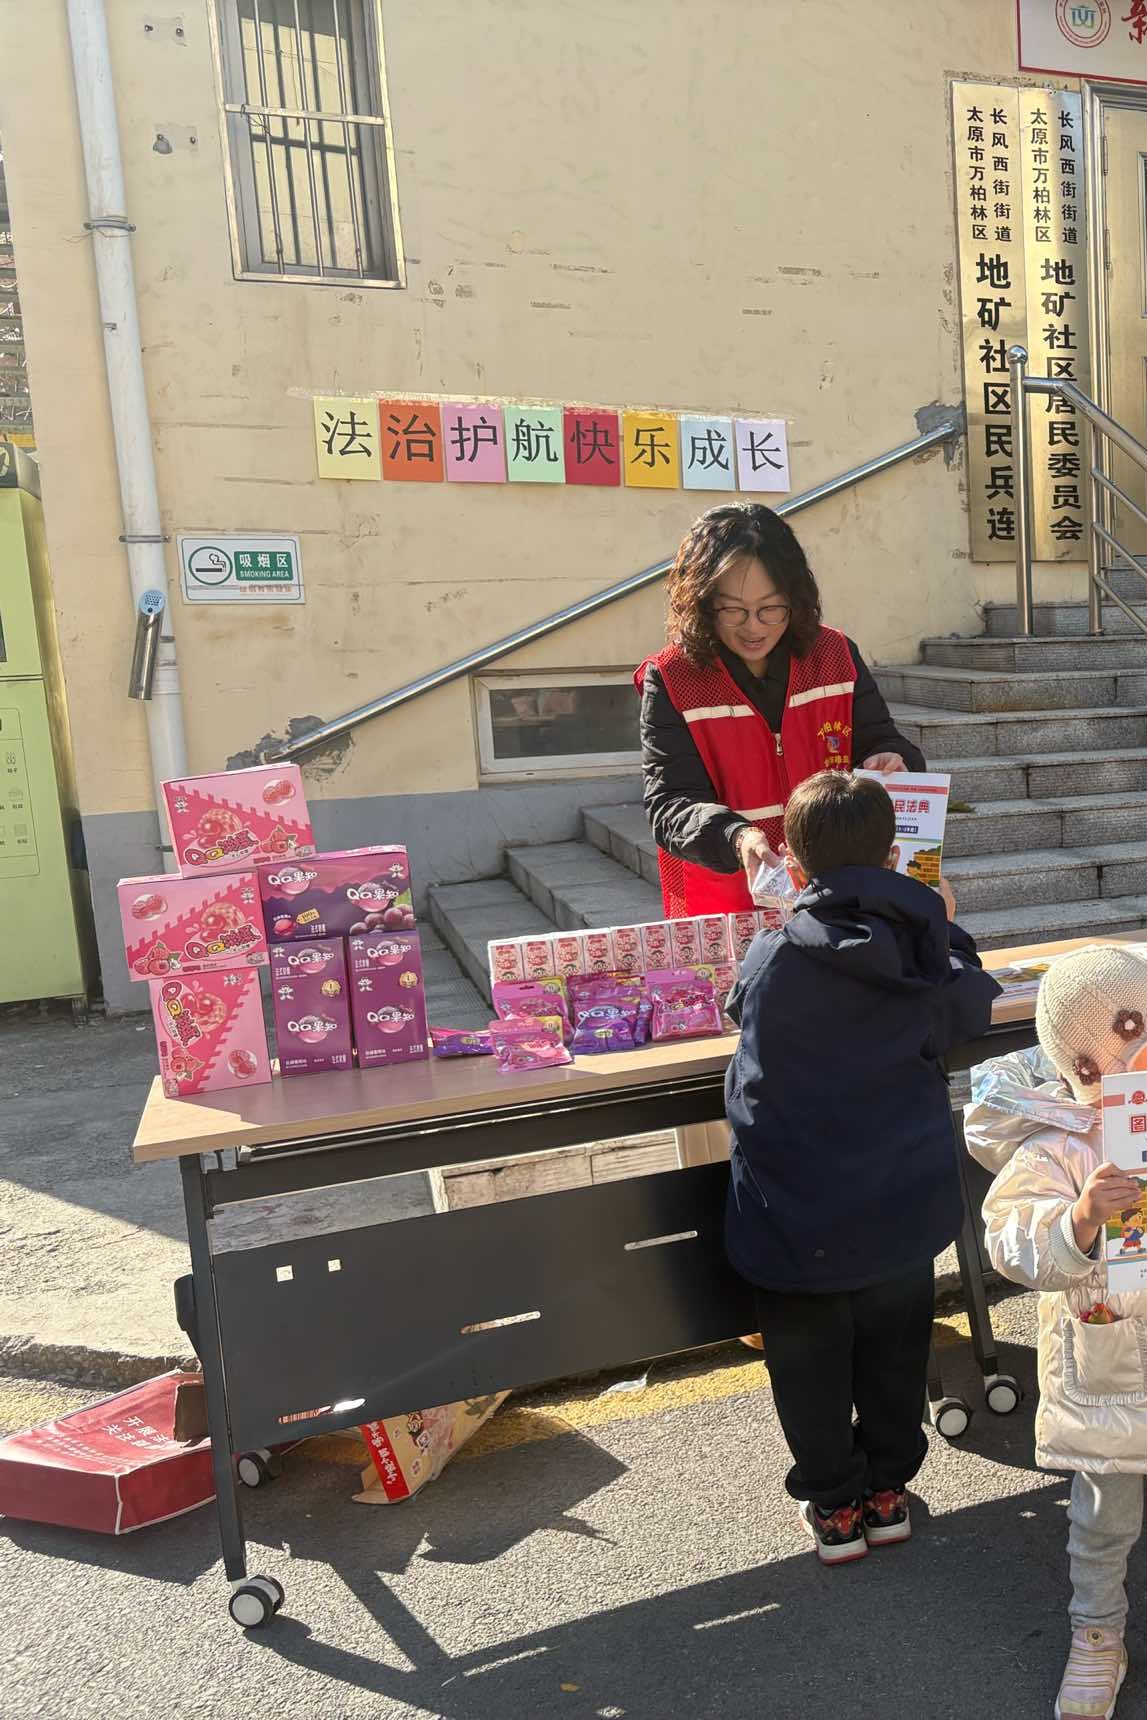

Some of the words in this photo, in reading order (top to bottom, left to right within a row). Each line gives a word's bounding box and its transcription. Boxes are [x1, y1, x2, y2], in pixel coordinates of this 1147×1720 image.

[967, 107, 988, 241] 太原市万柏林区
[990, 107, 1012, 243] 长风西街街道
[1030, 109, 1052, 243] 太原市万柏林区
[1057, 110, 1078, 245] 长风西街街道
[320, 410, 784, 475] 法治护航快乐成长
[976, 253, 1016, 541] 地矿社区民兵连
[239, 553, 289, 568] 吸烟区
[240, 570, 271, 578] SMOKING
[272, 570, 289, 578] AREA
